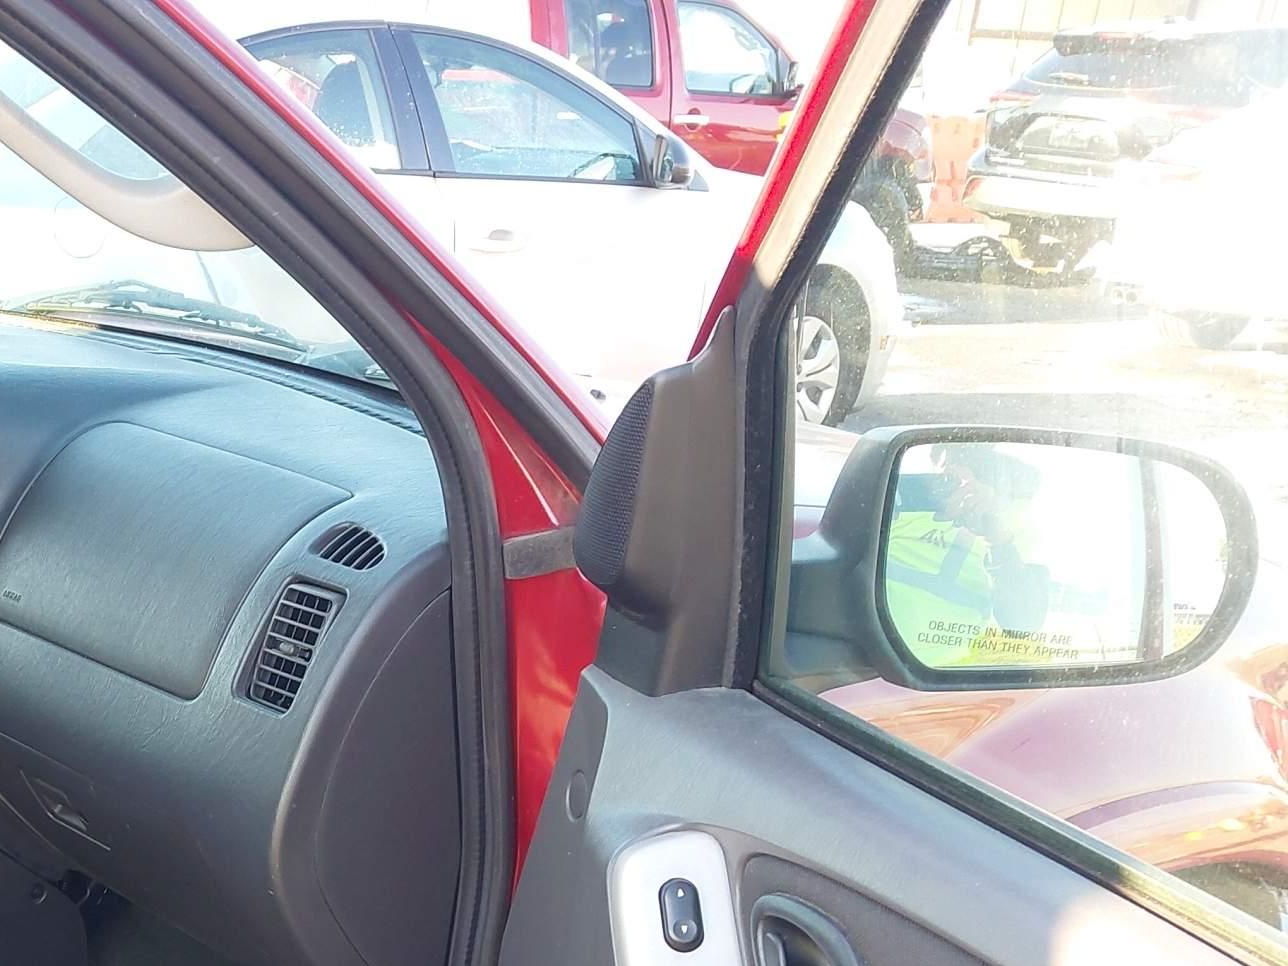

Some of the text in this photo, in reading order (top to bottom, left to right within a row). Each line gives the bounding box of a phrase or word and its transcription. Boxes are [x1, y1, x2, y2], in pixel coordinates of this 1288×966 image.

[917, 632, 1079, 660] CLOSER THAN THEY APPEAR
[928, 620, 1072, 646] OBJECTS IN MIRROR ARE
